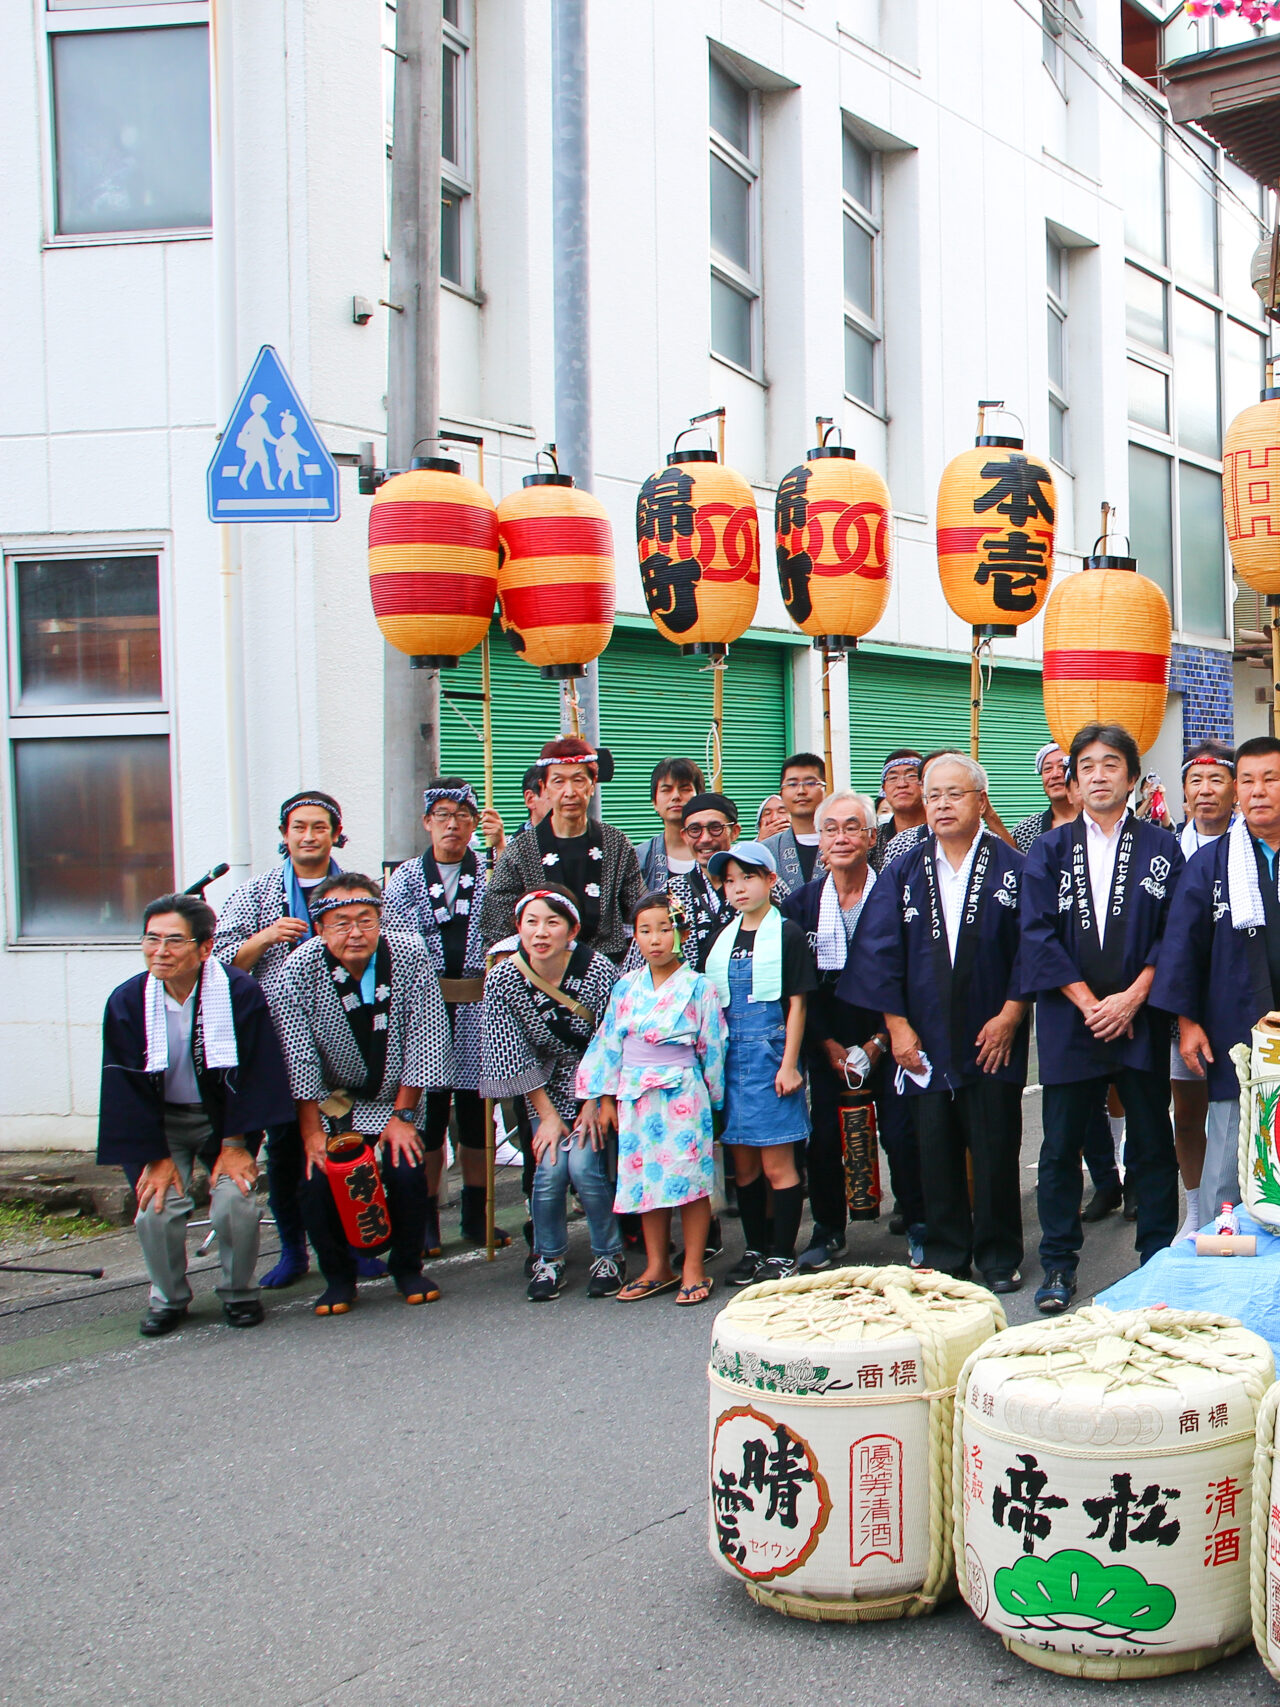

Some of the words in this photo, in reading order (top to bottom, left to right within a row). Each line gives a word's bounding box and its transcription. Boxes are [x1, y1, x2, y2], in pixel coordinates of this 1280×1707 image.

[972, 453, 1056, 612] 本壱
[1072, 843, 1091, 931] 小川町七夕まつり
[1112, 831, 1134, 916] 小川町七夕まつり
[857, 1359, 919, 1390] 商標
[1178, 1402, 1230, 1435] 商標
[860, 1443, 894, 1548] 優等清酒
[992, 1453, 1182, 1555] 帝松
[1204, 1475, 1244, 1568] 清酒
[748, 1537, 797, 1560] セイウン
